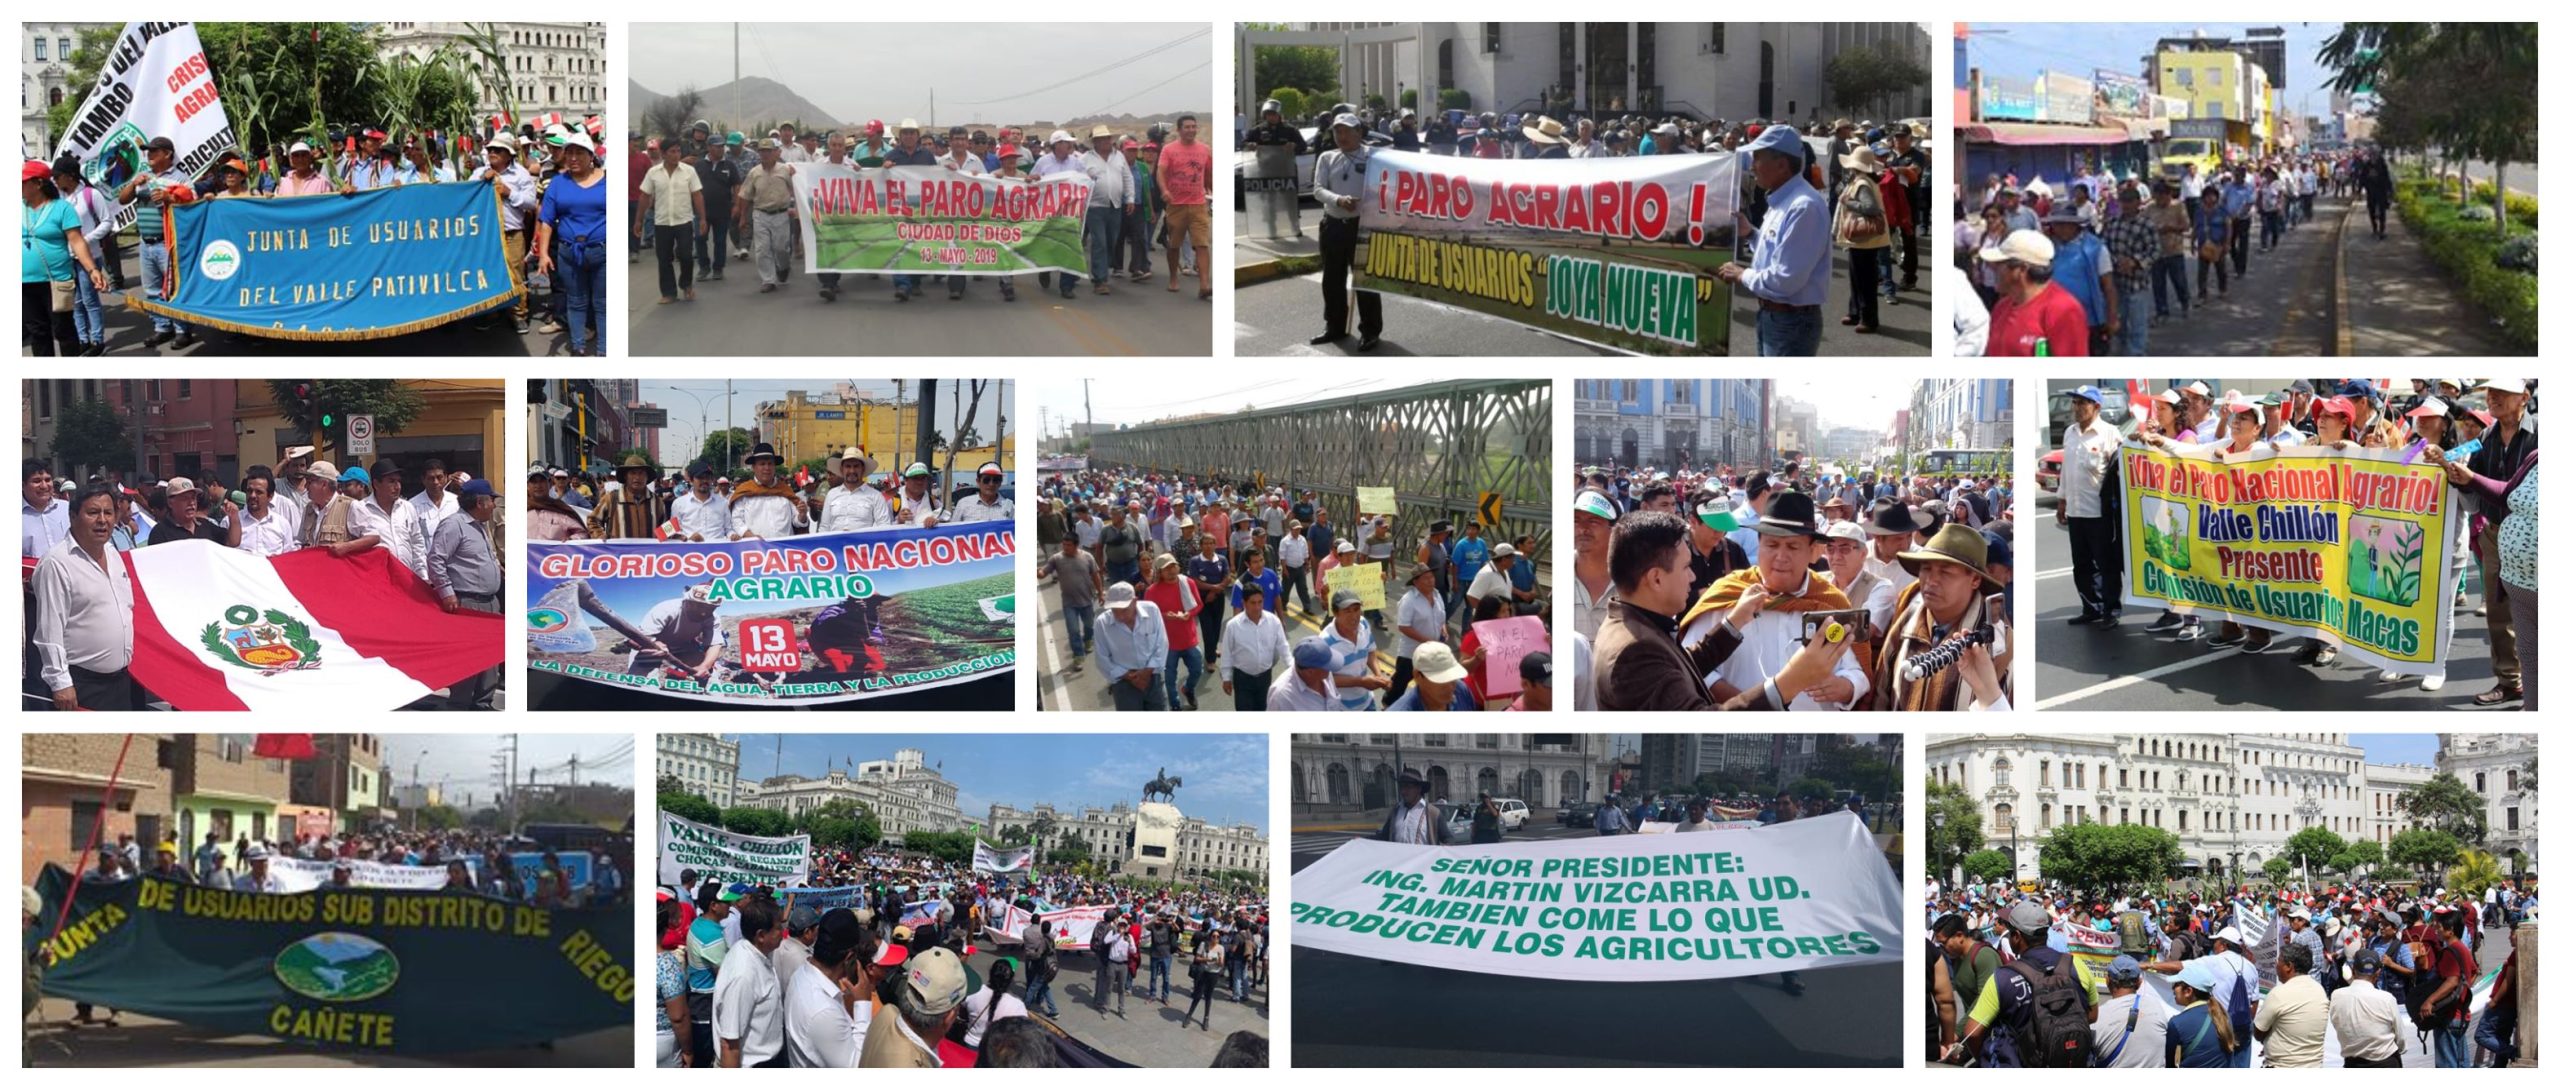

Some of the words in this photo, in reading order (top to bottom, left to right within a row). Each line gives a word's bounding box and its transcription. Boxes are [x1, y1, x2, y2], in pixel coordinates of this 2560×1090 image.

[69, 82, 133, 151] TAMBO
[813, 178, 878, 224] ¡VIVA
[886, 179, 914, 217] EL
[920, 180, 983, 218] PARO
[1394, 170, 1475, 221] PARO
[1486, 180, 1670, 242] AGRARIO
[247, 229, 309, 252] JUNTA
[329, 225, 352, 248] DE
[369, 214, 480, 244] USUARIOS
[897, 222, 955, 242] CIUDAD
[959, 223, 980, 242] DE
[984, 224, 1023, 243] DIOS
[920, 247, 933, 263] 13
[939, 247, 967, 264] MAYO
[974, 247, 998, 264] 2019
[1365, 232, 1416, 282] JUNTA
[1417, 237, 1440, 287] DE
[1440, 241, 1536, 308] USUARIOS
[240, 286, 280, 307] DEL
[293, 280, 357, 304] VALLE
[372, 268, 489, 297] PATIVILCA
[2169, 462, 2187, 497] el
[2188, 463, 2230, 505] Paro
[2230, 463, 2340, 504] Nacional
[2343, 463, 2443, 515] Agrario!
[2199, 503, 2254, 543] Valle
[2256, 503, 2340, 546] Chillón
[540, 552, 733, 579] GLORIOSO
[742, 548, 837, 575] PARO
[2217, 545, 2324, 584] Presente
[707, 574, 875, 601] AGRARIO
[2224, 582, 2256, 613] de
[2254, 584, 2344, 632] Usuarios
[2347, 598, 2420, 656] Macas
[749, 625, 786, 653] 13
[533, 660, 562, 673] LA
[565, 664, 660, 688] DEFENSA
[666, 680, 704, 692] DEL
[708, 683, 768, 697] AGUA,
[772, 683, 843, 697] TIERRA
[843, 681, 860, 693] Y
[864, 677, 891, 690] LA
[892, 651, 1015, 684] PRODUCCION
[745, 652, 797, 667] MAYO
[668, 820, 729, 848] VALLE
[676, 854, 726, 867] CHOCAS
[734, 861, 793, 874] CABALLERO
[734, 852, 748, 863] DE
[750, 856, 801, 866] REGANTES
[1431, 855, 1533, 878] SEÑOR
[1541, 852, 1745, 879] PRESIDENTE:
[1361, 869, 1428, 893] ING.
[1438, 876, 1564, 902] MARTIN
[1574, 878, 1740, 904] VIZCARRA
[1748, 875, 1811, 901] UD.
[1291, 901, 1486, 950] PRODUCEN
[1492, 930, 1566, 958] LOS
[1574, 931, 1881, 961] AGRICULTORES
[1377, 892, 1530, 927] TAMBIEN
[1538, 907, 1637, 932] COME
[1649, 907, 1693, 933] LO
[1704, 906, 1785, 934] QUE
[138, 877, 177, 911] DE
[182, 887, 315, 922] USUARIOS
[323, 892, 374, 926] SUB
[384, 896, 505, 931] DISTRITO
[514, 908, 550, 936] DE
[560, 929, 634, 1005] RIEGO
[270, 1004, 395, 1046] CAÑETE
